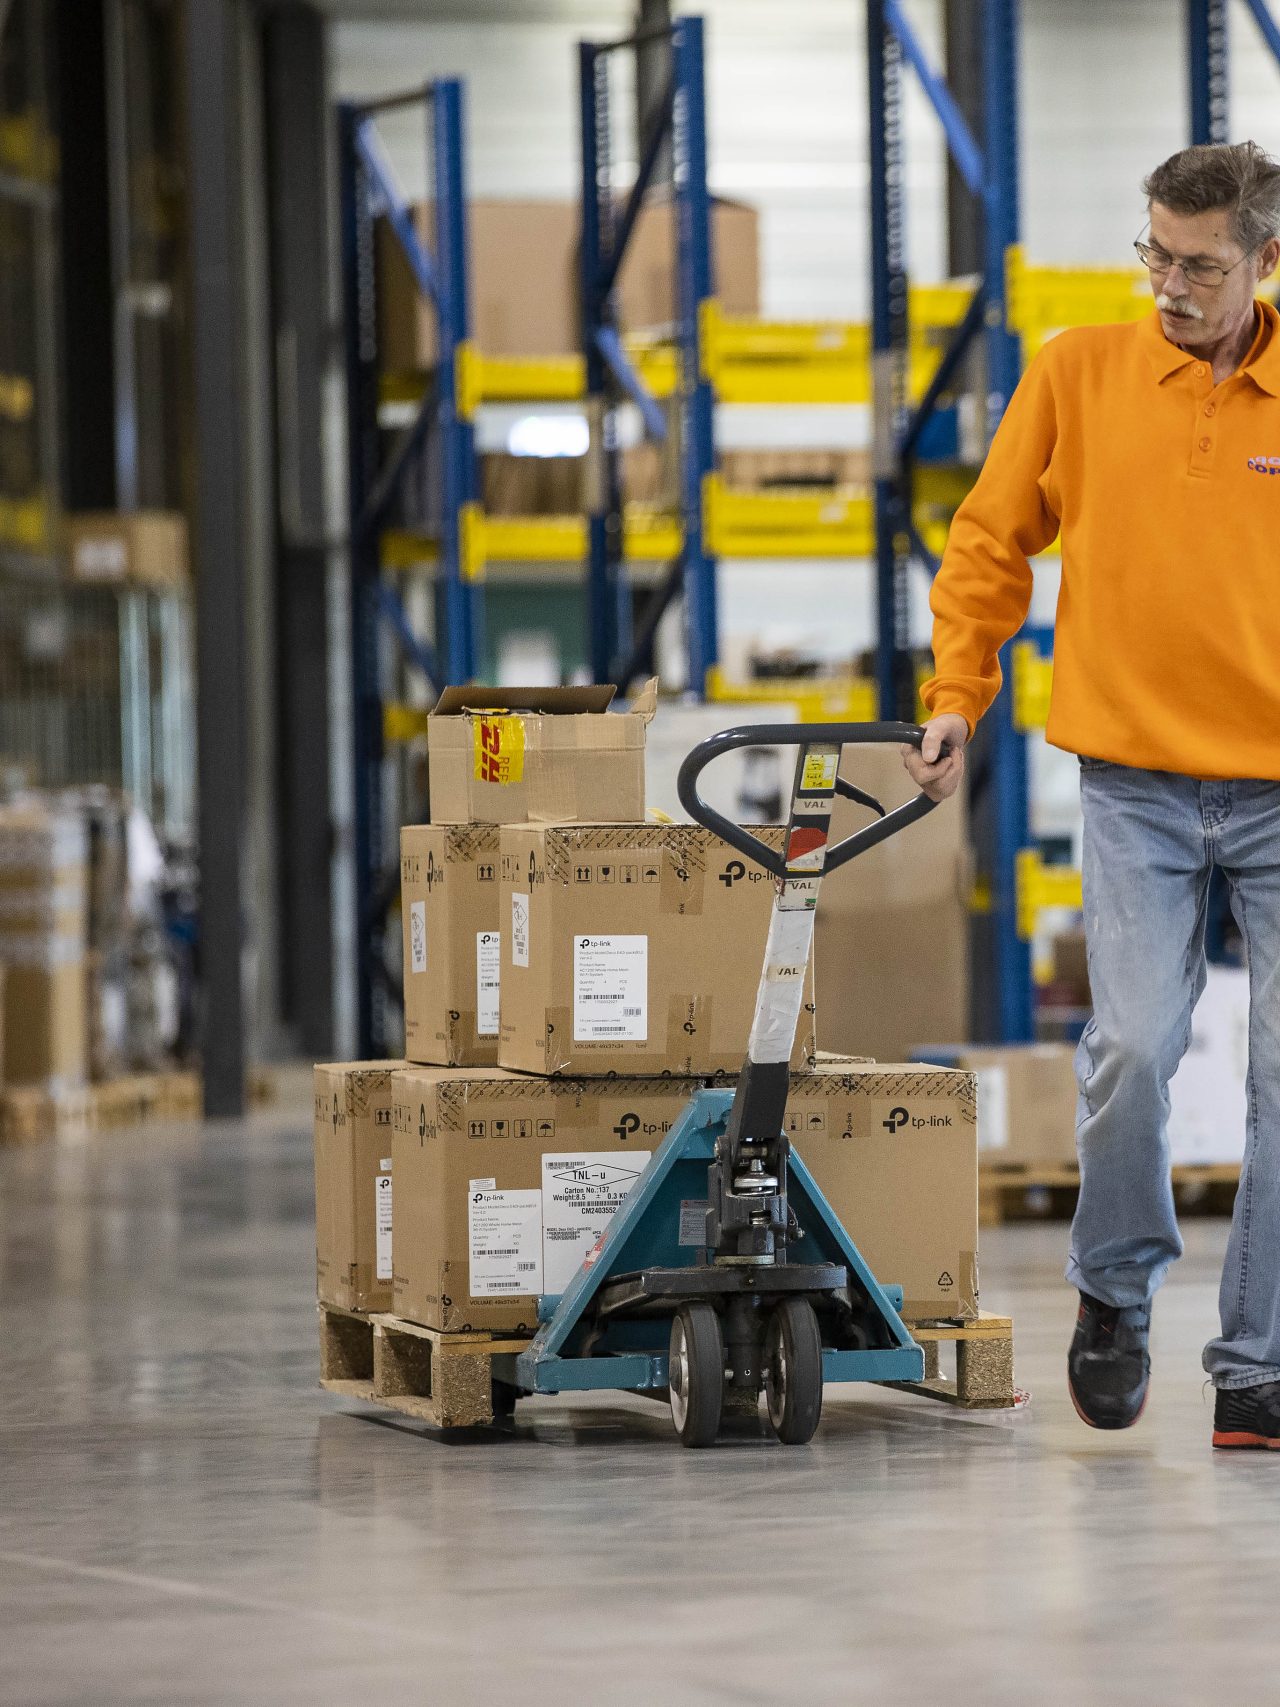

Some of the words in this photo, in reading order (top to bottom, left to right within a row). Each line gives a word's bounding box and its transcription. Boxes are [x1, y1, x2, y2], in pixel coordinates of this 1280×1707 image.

[804, 801, 827, 809] VAL
[791, 882, 817, 890] VAL
[911, 1114, 953, 1130] tp-link
[483, 1194, 505, 1202] tp-link
